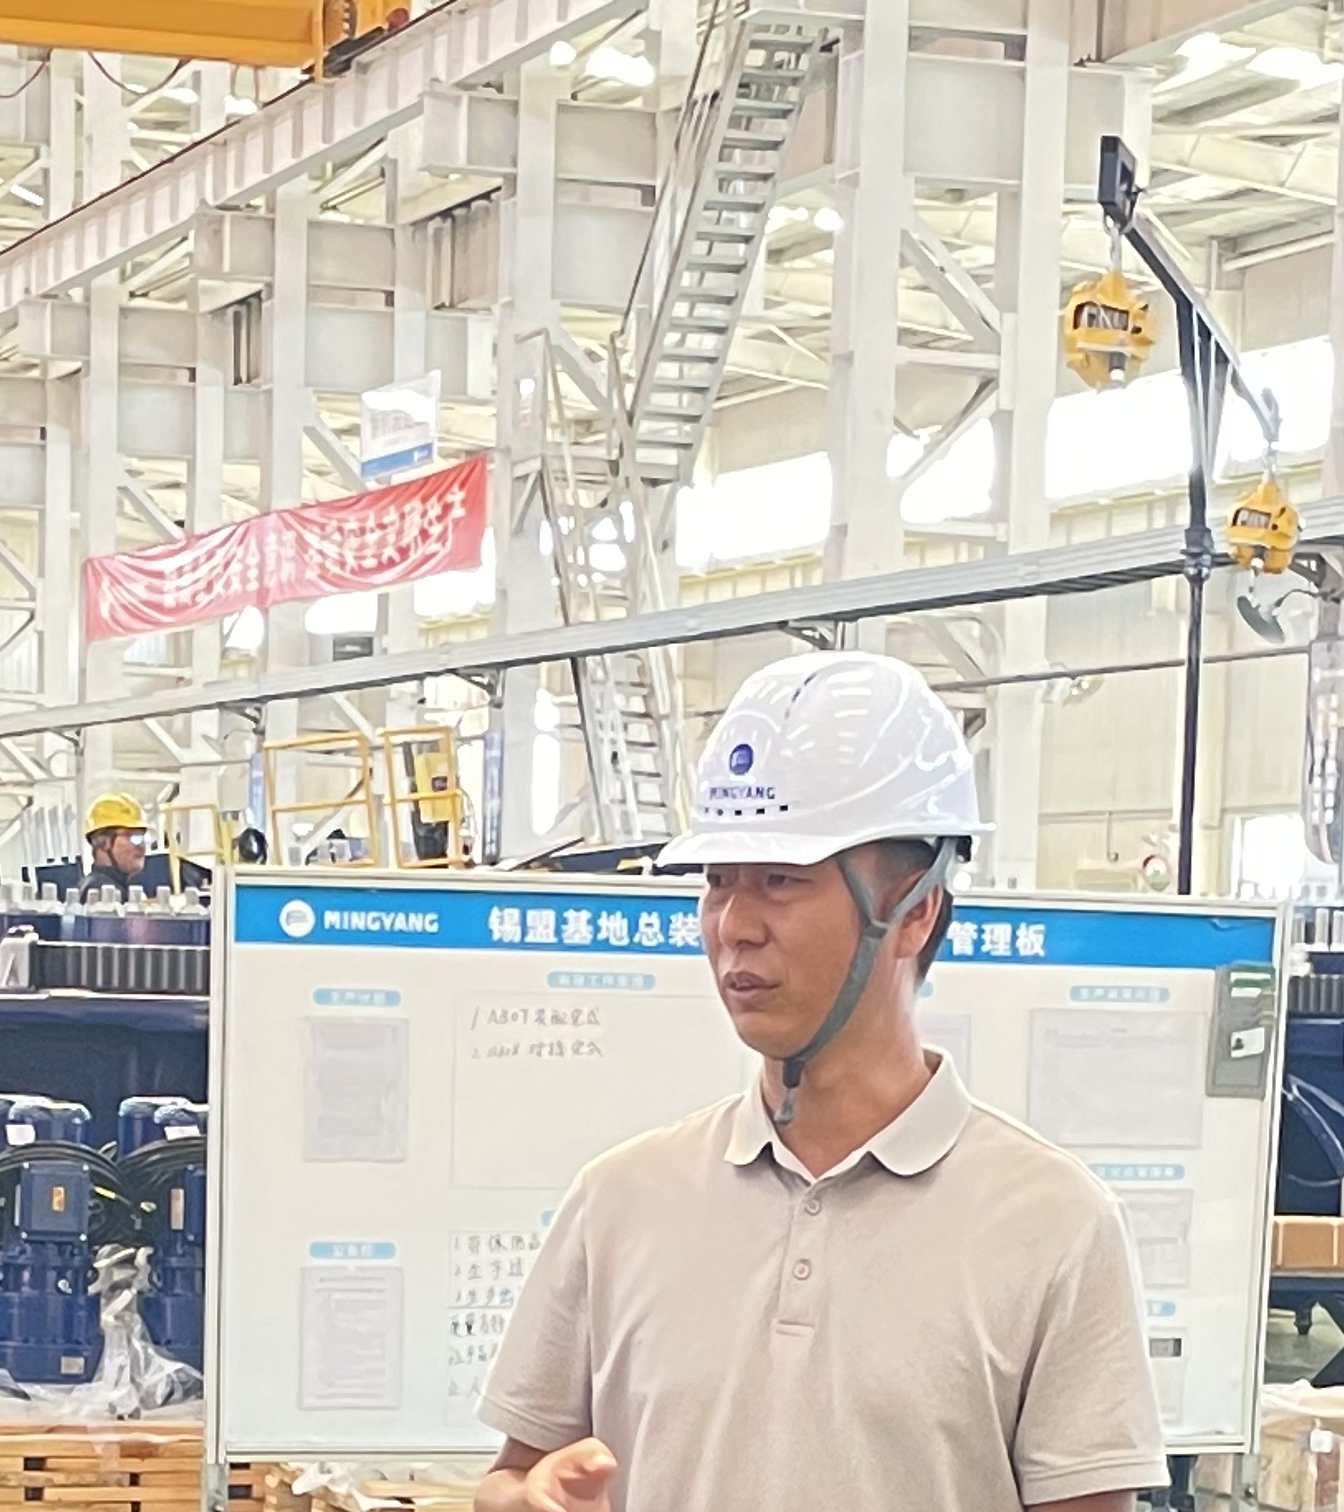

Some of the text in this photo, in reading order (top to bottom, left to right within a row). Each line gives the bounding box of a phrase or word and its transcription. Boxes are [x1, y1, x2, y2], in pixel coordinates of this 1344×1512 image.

[323, 909, 440, 933] MINGYANG
[488, 906, 1046, 957] 锡盟基地总装 管理板
